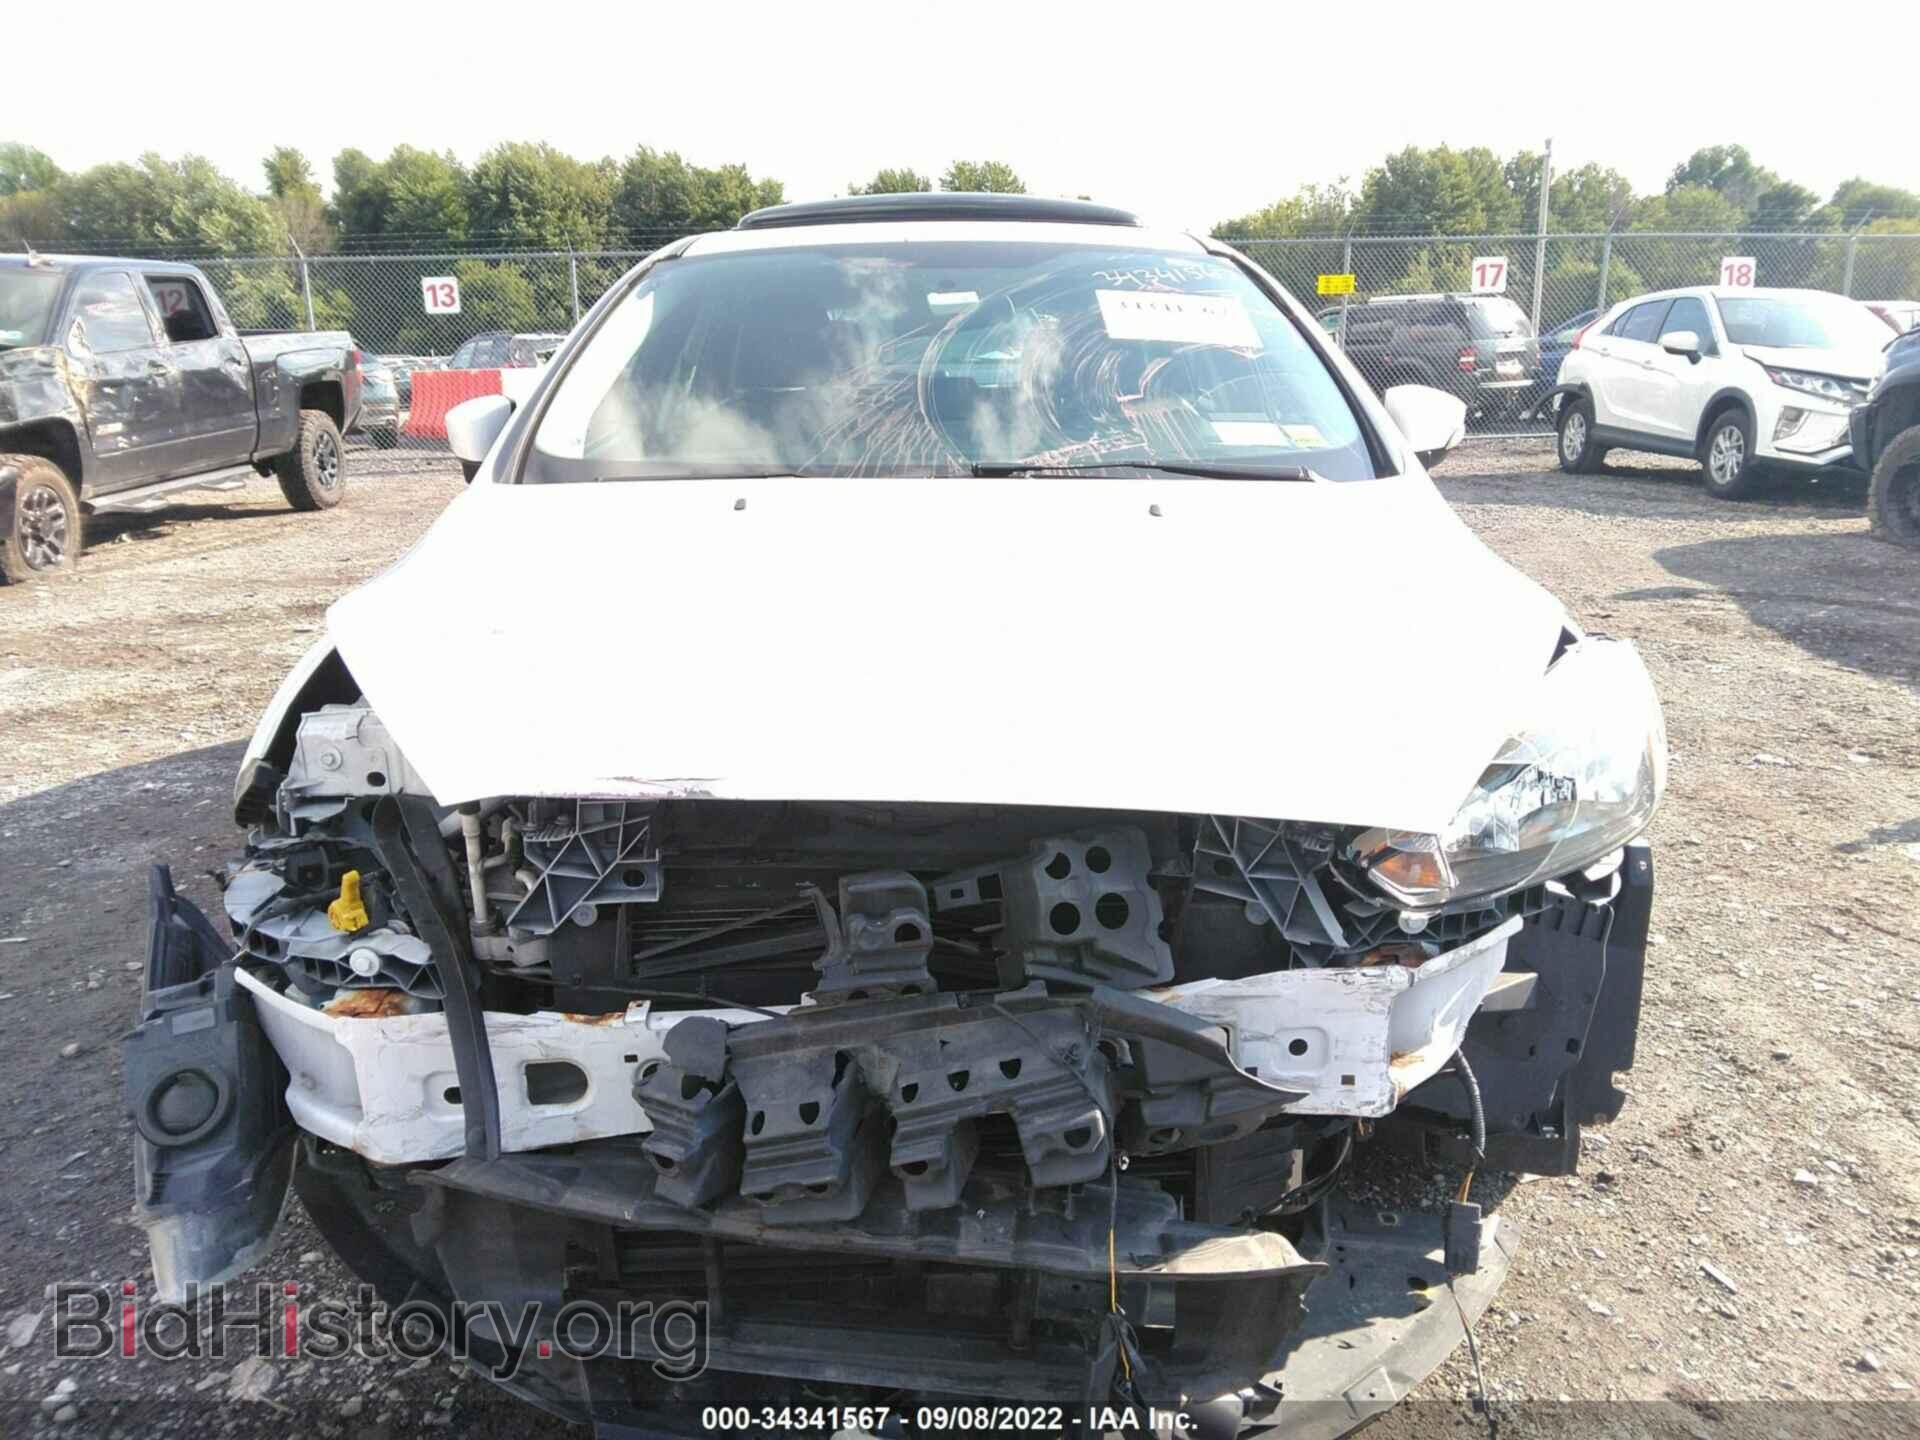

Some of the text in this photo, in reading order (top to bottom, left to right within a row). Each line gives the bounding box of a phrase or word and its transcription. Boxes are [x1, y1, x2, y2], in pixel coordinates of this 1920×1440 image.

[1475, 263, 1504, 287] 17
[1724, 263, 1753, 287] 18
[154, 288, 184, 316] 12
[426, 283, 456, 308] 13
